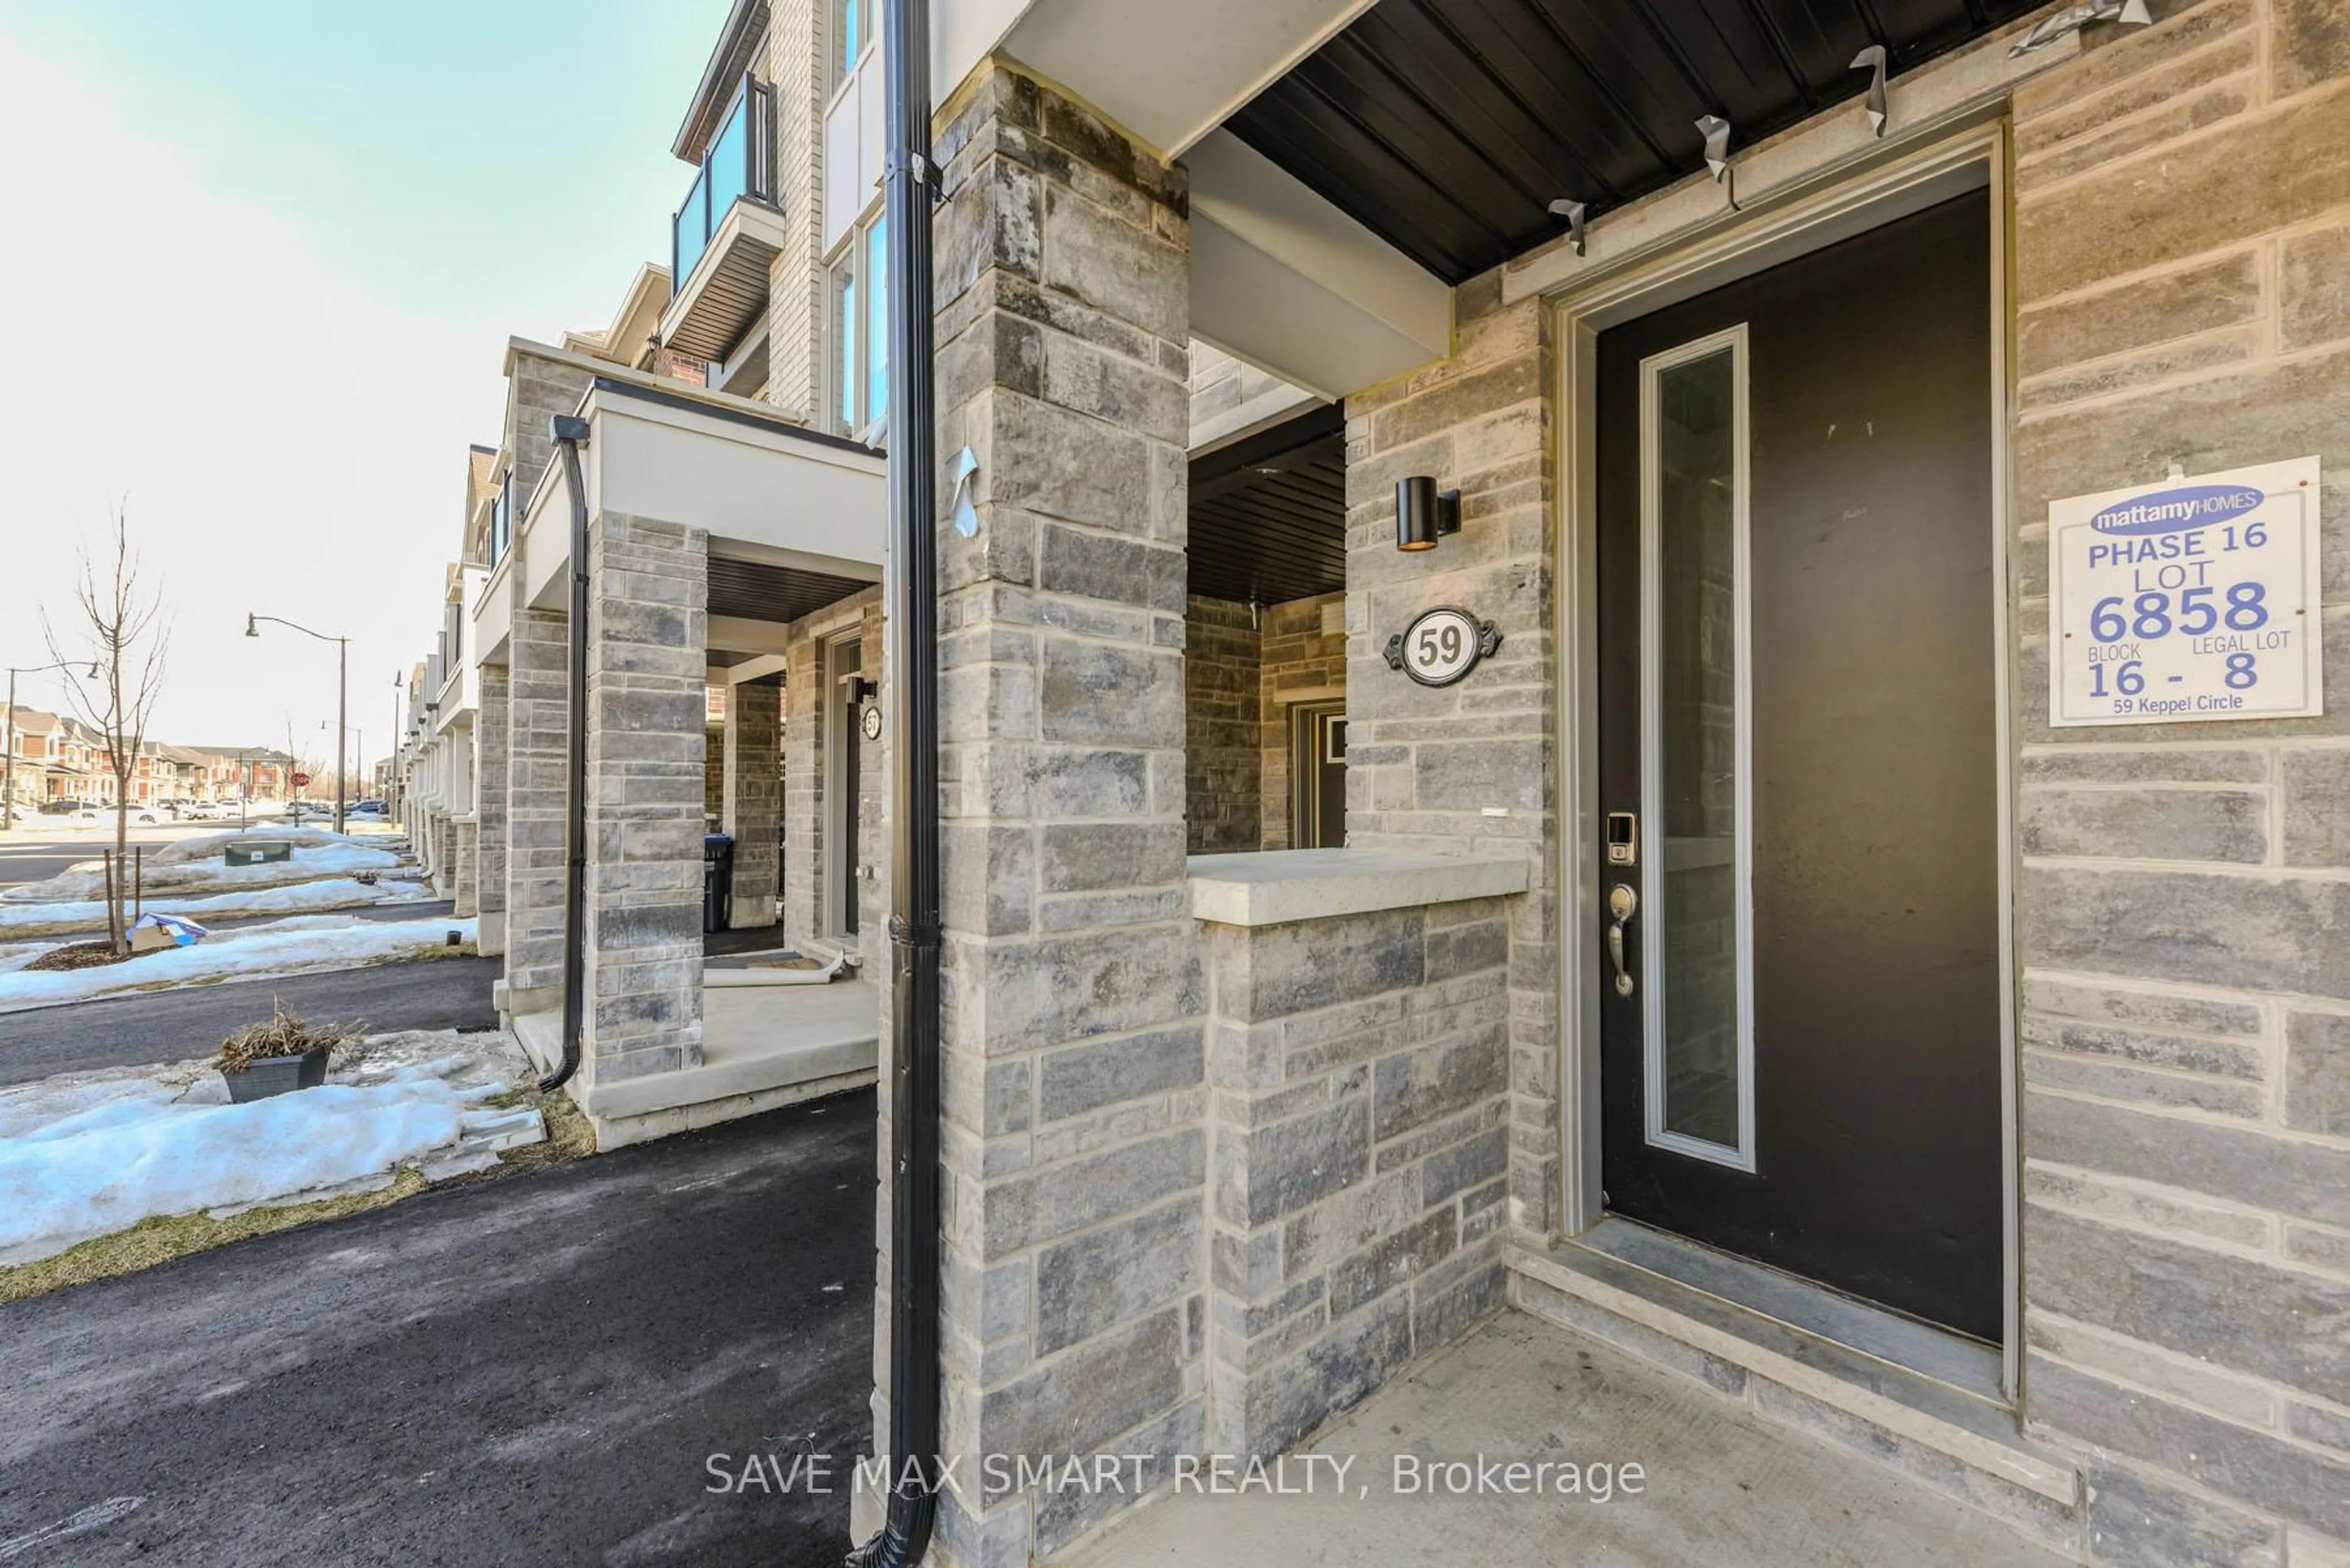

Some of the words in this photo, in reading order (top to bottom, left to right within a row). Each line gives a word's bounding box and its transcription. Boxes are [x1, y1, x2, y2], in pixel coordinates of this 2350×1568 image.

[2089, 531, 2204, 568] PHASE
[2222, 522, 2267, 551] 16
[2135, 561, 2215, 592] LOT
[2090, 582, 2269, 643] 6858
[1419, 625, 1461, 666] 59
[2089, 644, 2141, 662] BLOCK
[2193, 635, 2249, 654] LEGAL
[2256, 631, 2291, 650] LOT
[2089, 661, 2145, 697] 16
[2225, 653, 2257, 689] 8
[2114, 699, 2133, 714] 59
[2139, 697, 2191, 715] Keppel
[2197, 695, 2243, 710] Circle
